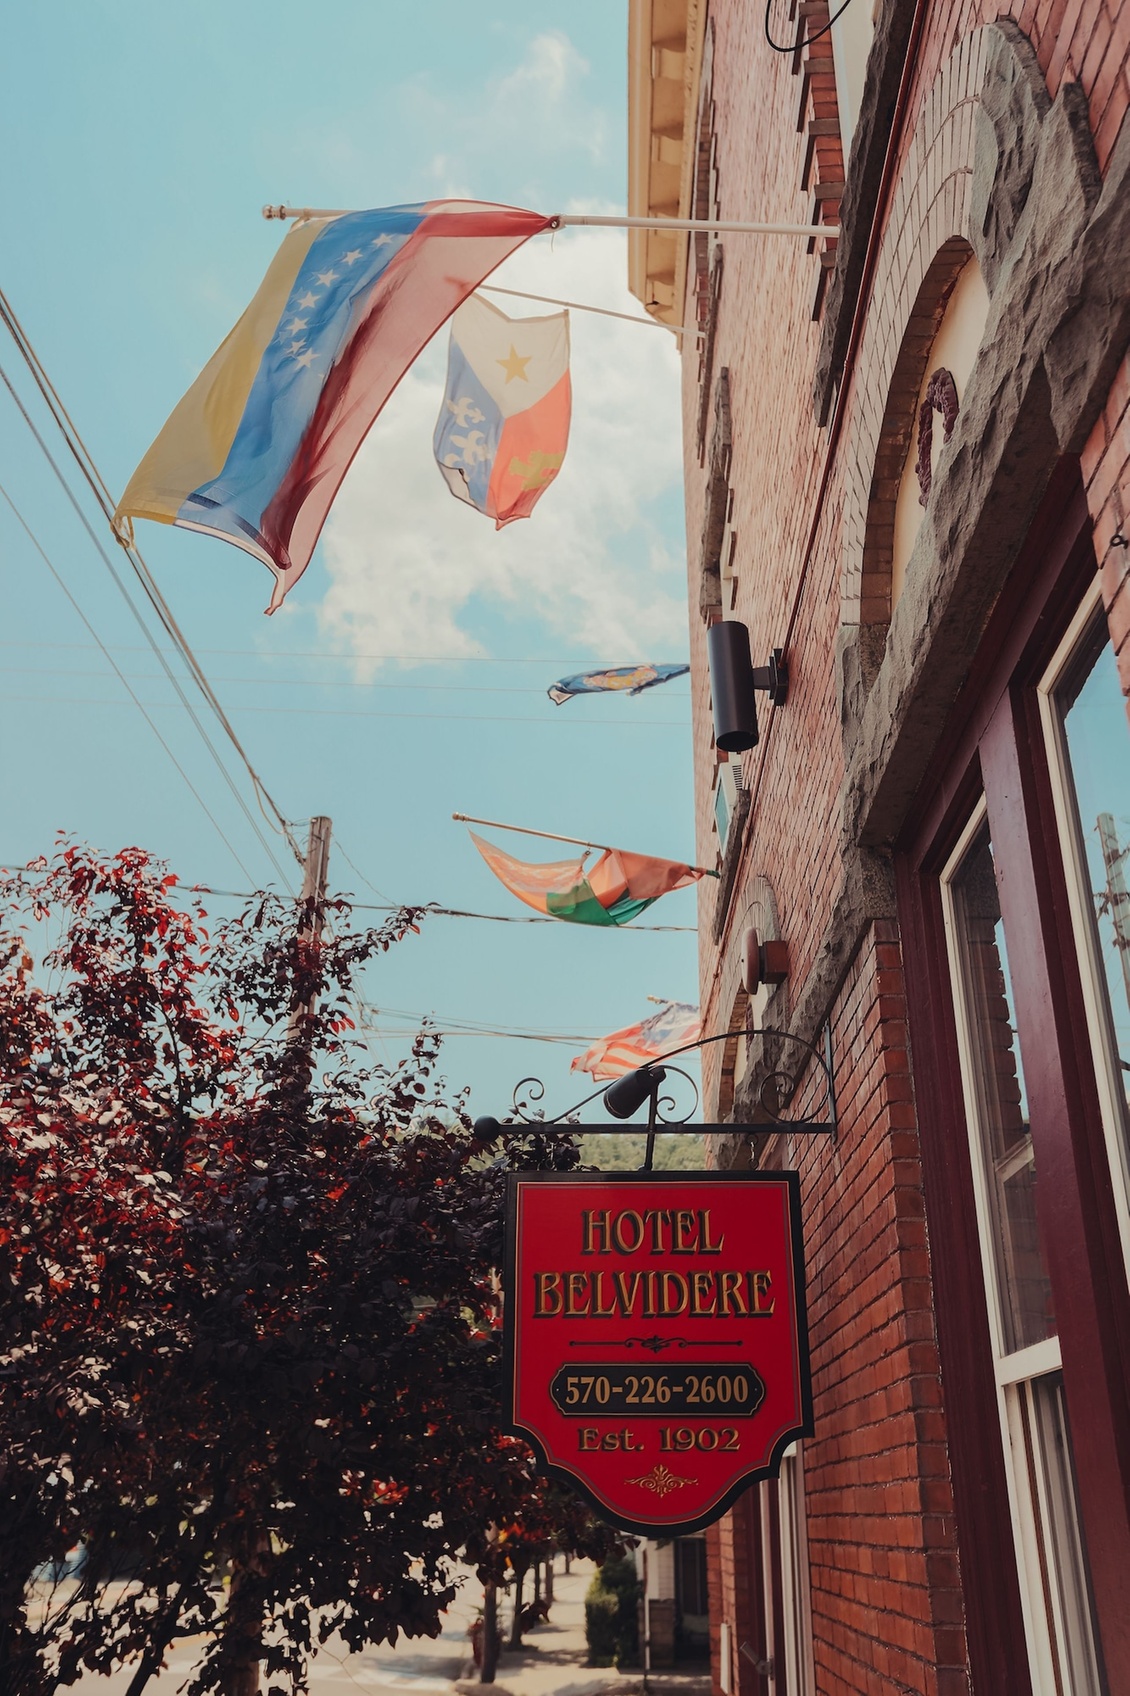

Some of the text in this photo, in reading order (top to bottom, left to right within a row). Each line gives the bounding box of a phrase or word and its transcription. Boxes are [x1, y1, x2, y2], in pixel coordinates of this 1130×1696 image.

[582, 1209, 725, 1255] HOTEL
[533, 1270, 776, 1318] BELVIDERE
[566, 1375, 749, 1404] 570-226-2600
[577, 1427, 741, 1452] Est. 1902
